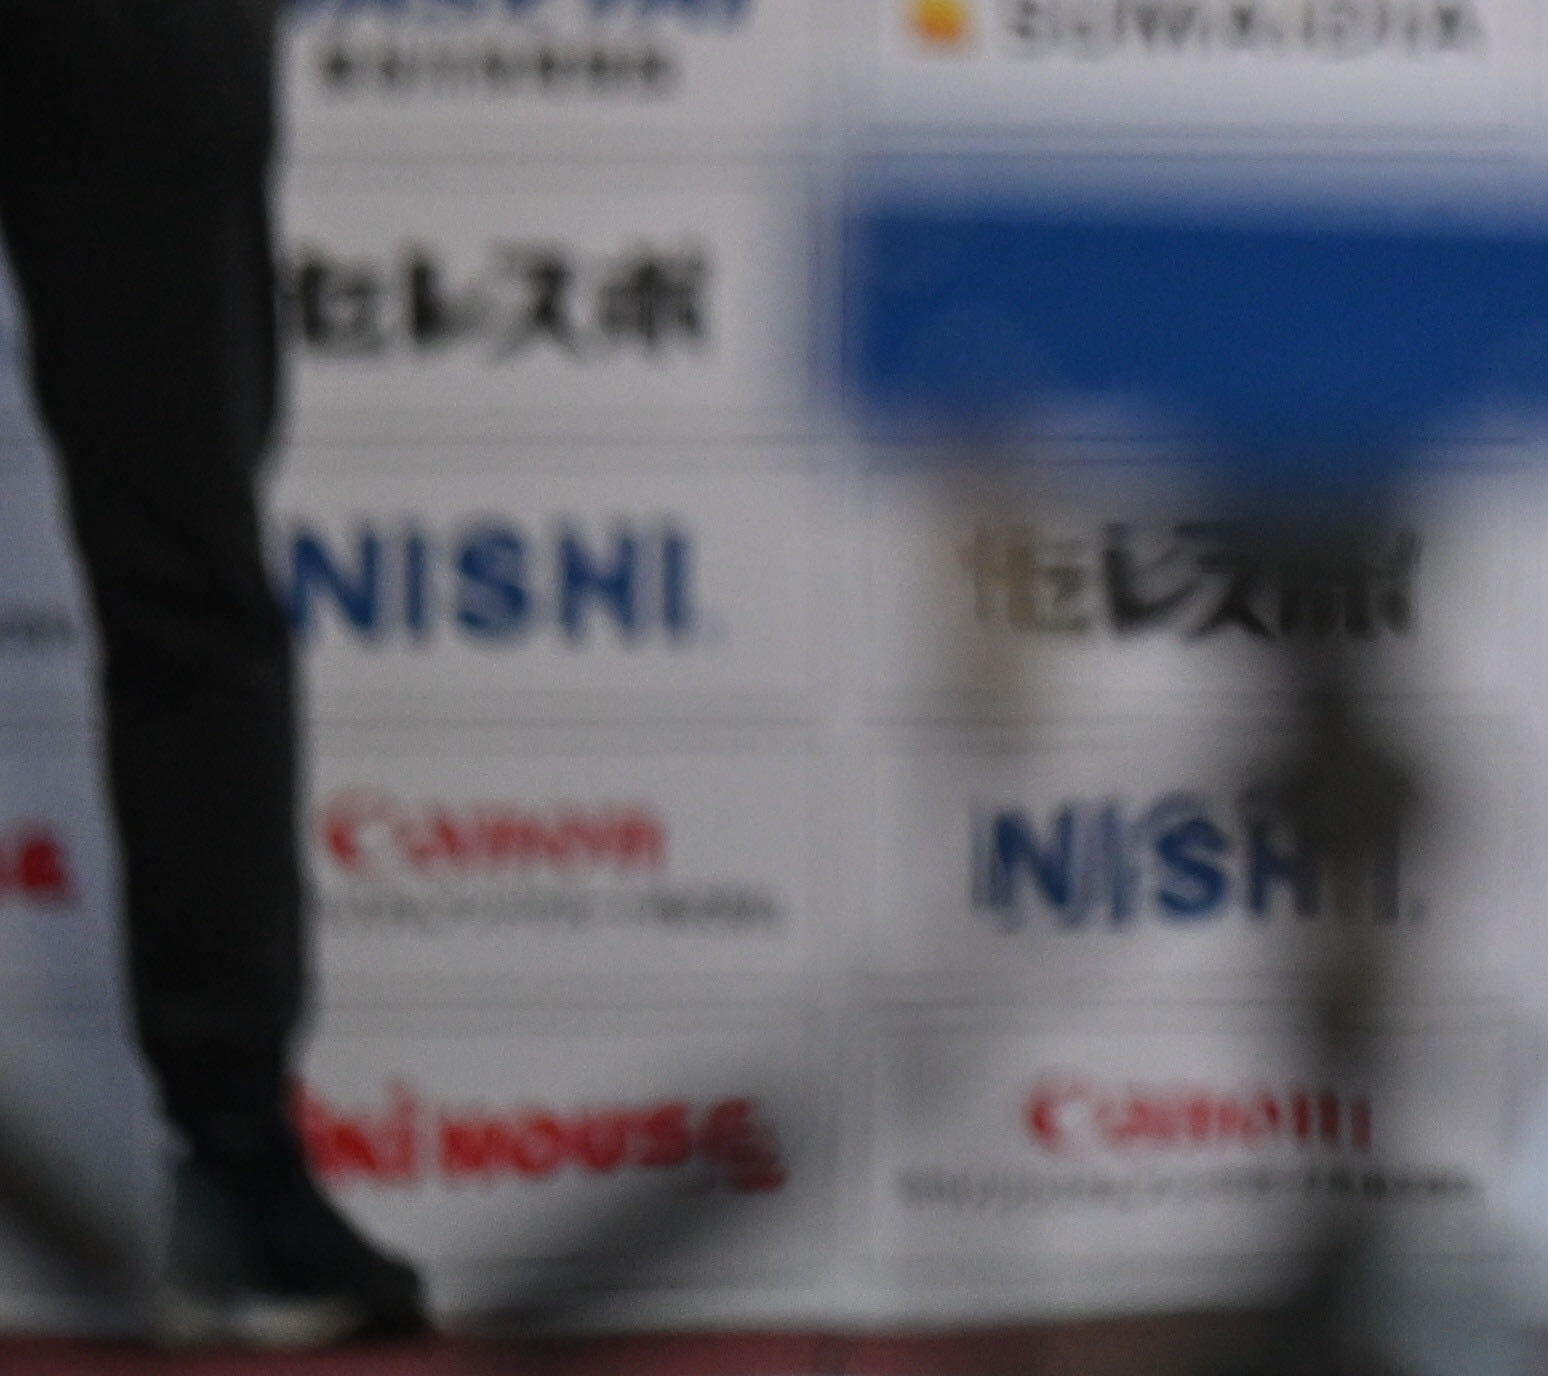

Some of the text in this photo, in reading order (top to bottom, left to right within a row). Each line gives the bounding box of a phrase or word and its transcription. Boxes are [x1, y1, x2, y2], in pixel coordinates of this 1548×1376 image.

[278, 248, 712, 360] セレスポ
[284, 520, 692, 642] NISHI
[320, 786, 666, 878] Canon
[1024, 1064, 1372, 1158] Canon
